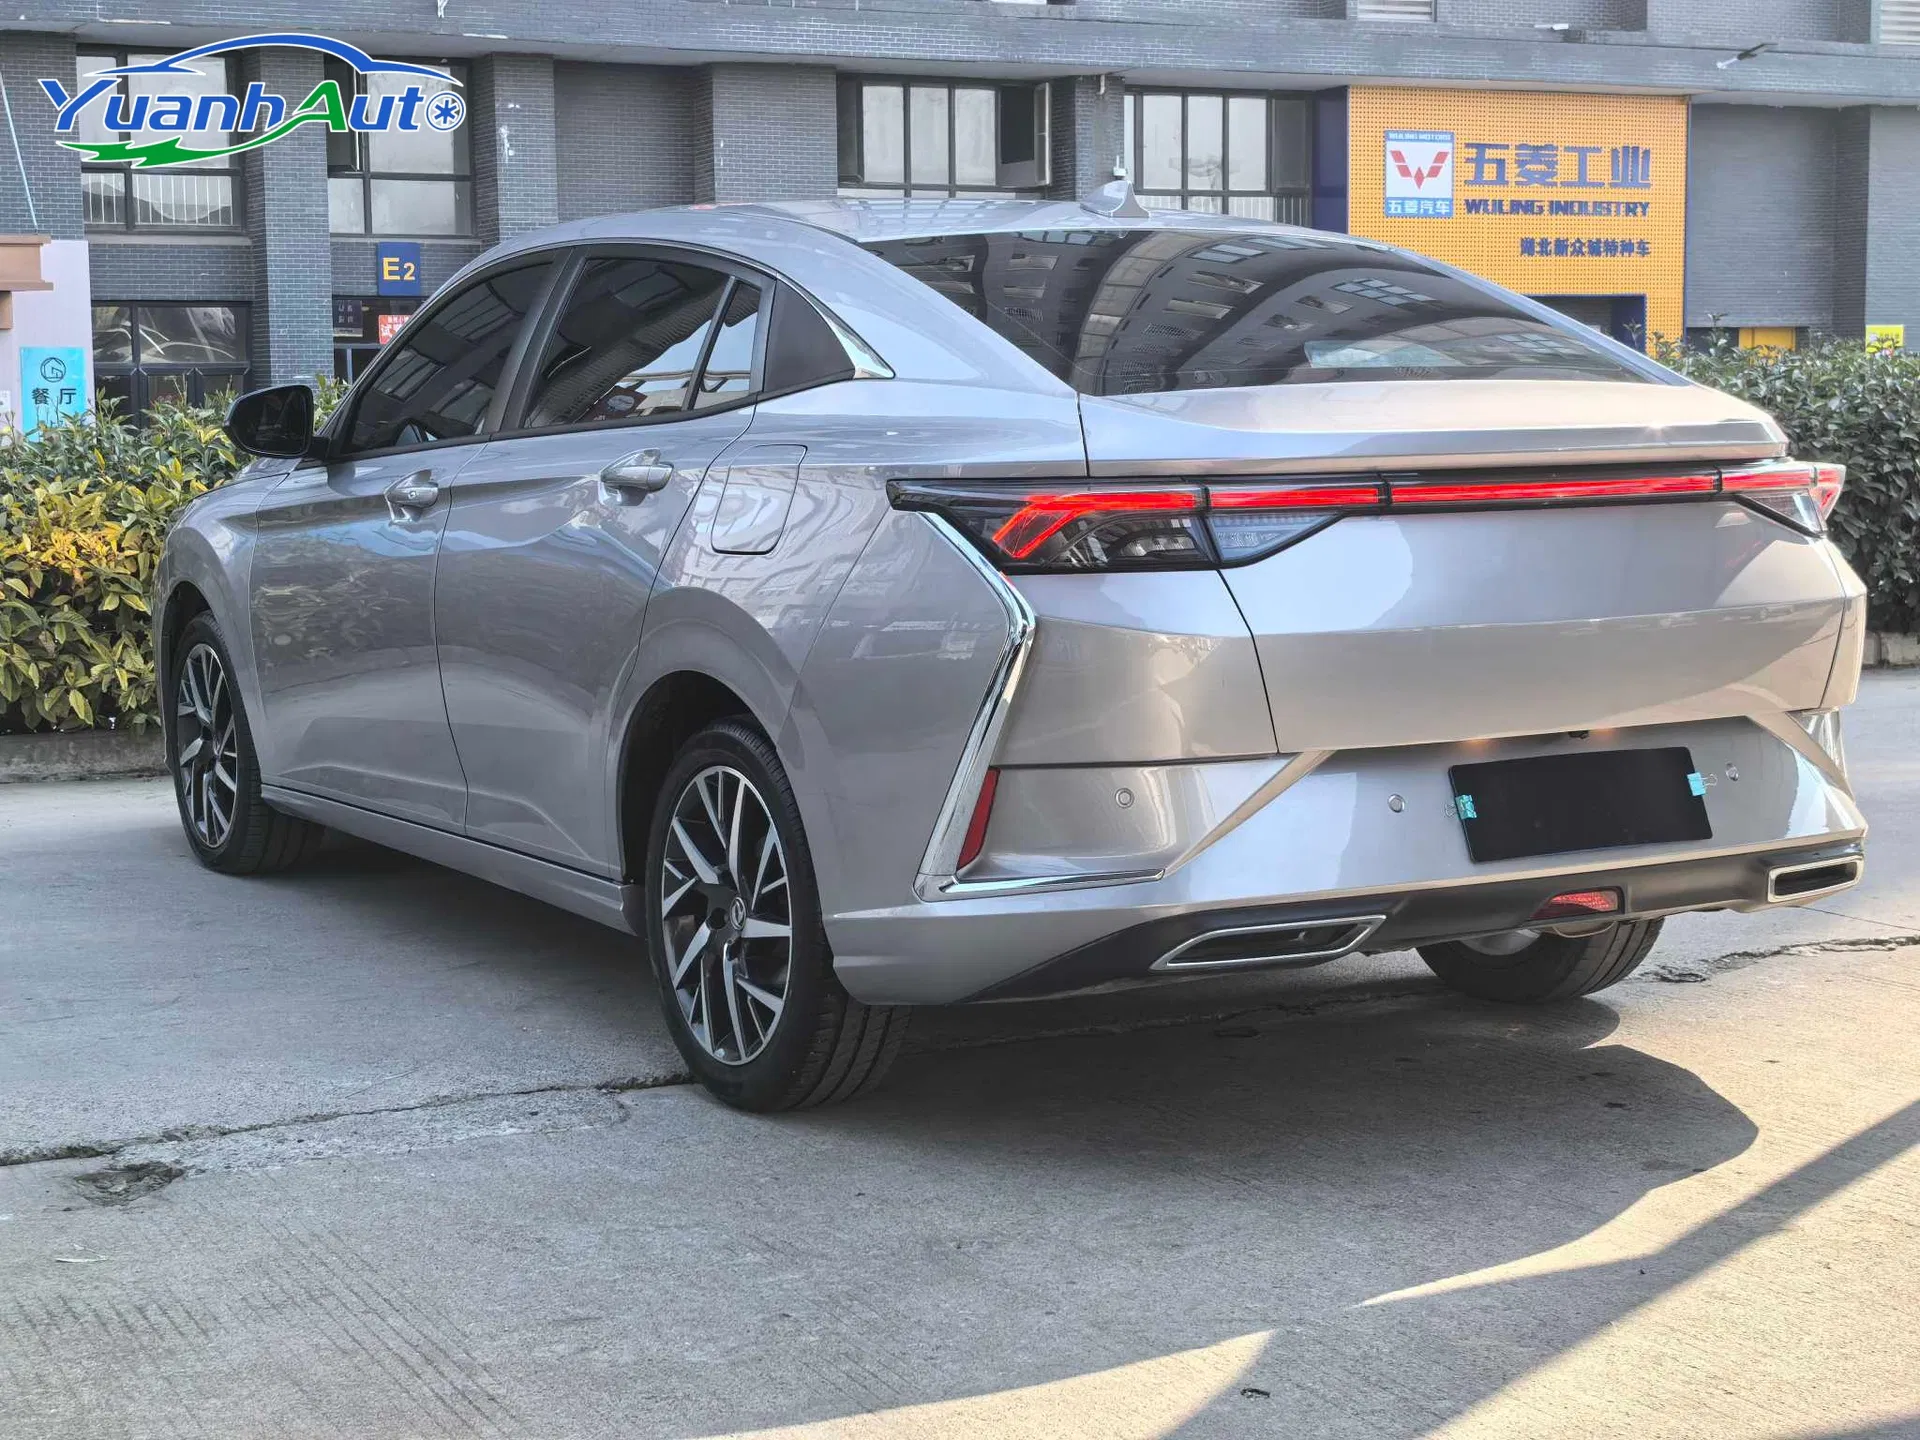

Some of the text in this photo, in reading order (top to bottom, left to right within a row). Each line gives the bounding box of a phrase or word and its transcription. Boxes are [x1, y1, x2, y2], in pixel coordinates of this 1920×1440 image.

[1463, 142, 1652, 189] 五菱工业
[1388, 200, 1450, 215] 五菱汽车
[1464, 199, 1650, 217] WULING INDUSTRY
[382, 257, 416, 281] E2
[31, 387, 77, 405] 餐厅
